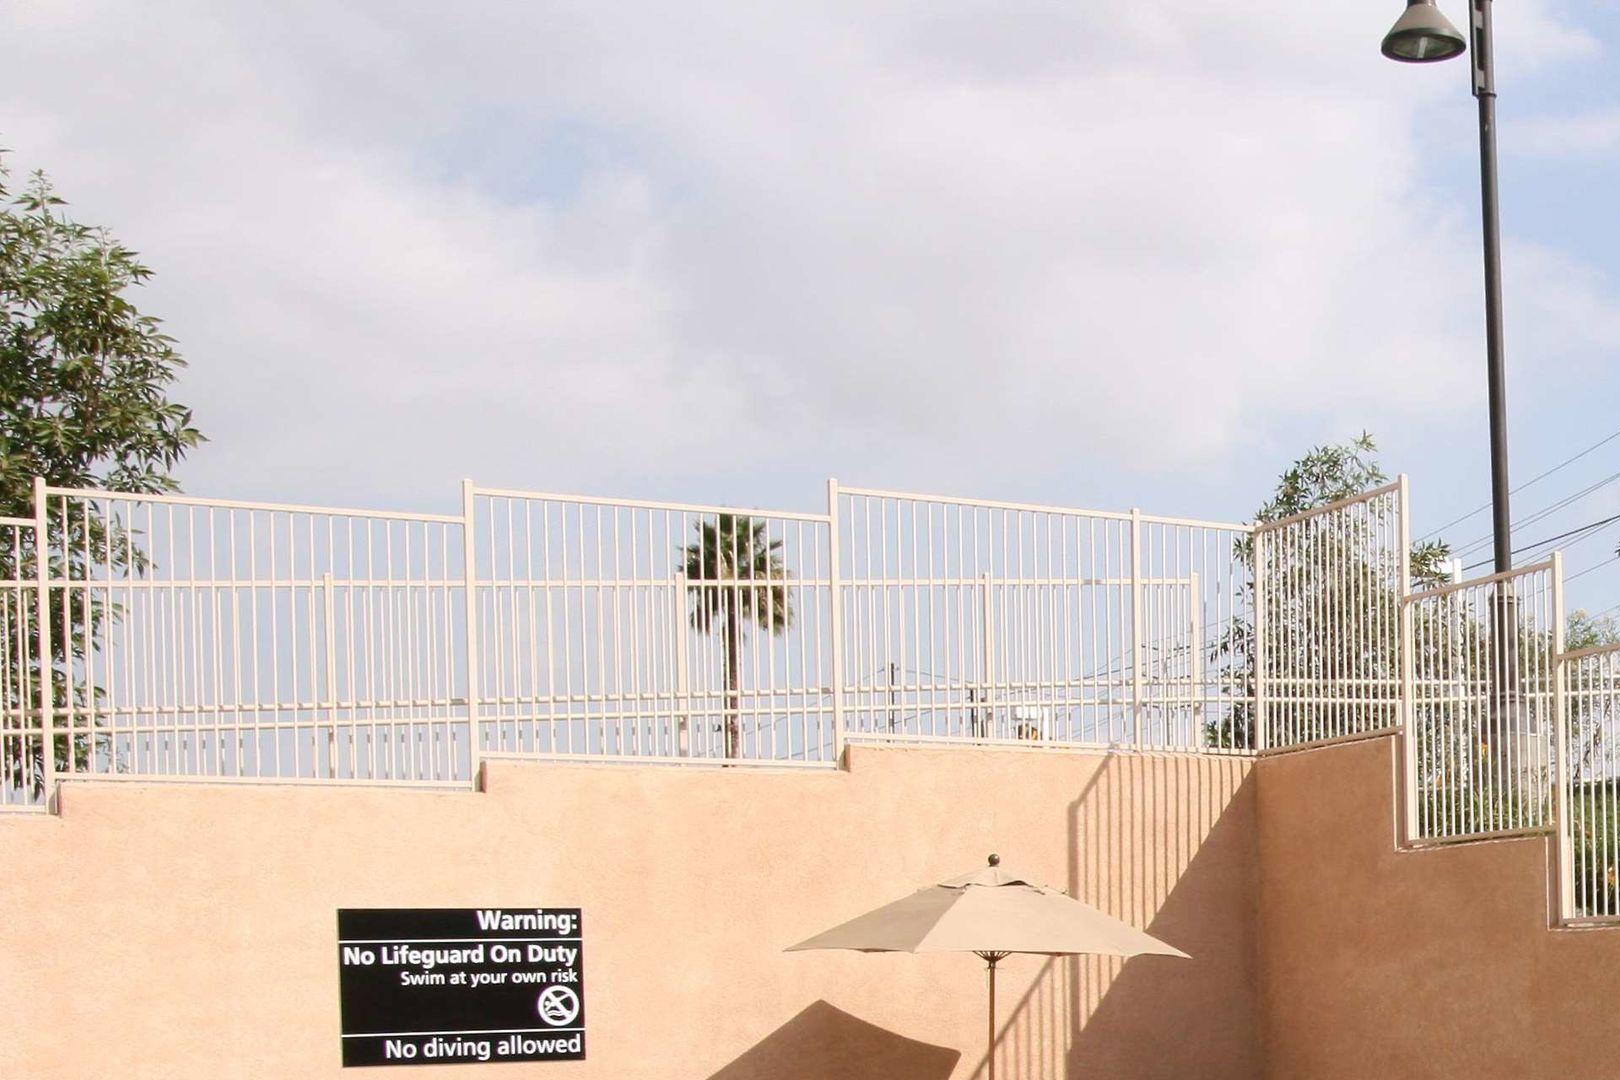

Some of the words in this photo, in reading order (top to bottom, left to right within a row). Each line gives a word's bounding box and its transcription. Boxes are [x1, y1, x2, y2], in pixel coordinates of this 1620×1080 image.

[477, 909, 578, 935] Warning:
[343, 947, 375, 965] No
[382, 945, 484, 968] Lifeguard
[490, 945, 521, 963] On
[528, 945, 577, 966] Duty
[400, 971, 445, 986] Swim
[450, 970, 466, 985] at
[471, 971, 507, 987] your
[512, 971, 546, 983] own
[551, 969, 578, 983] risk
[386, 1039, 417, 1059] No
[424, 1037, 490, 1060] diving
[497, 1034, 581, 1056] allowed
